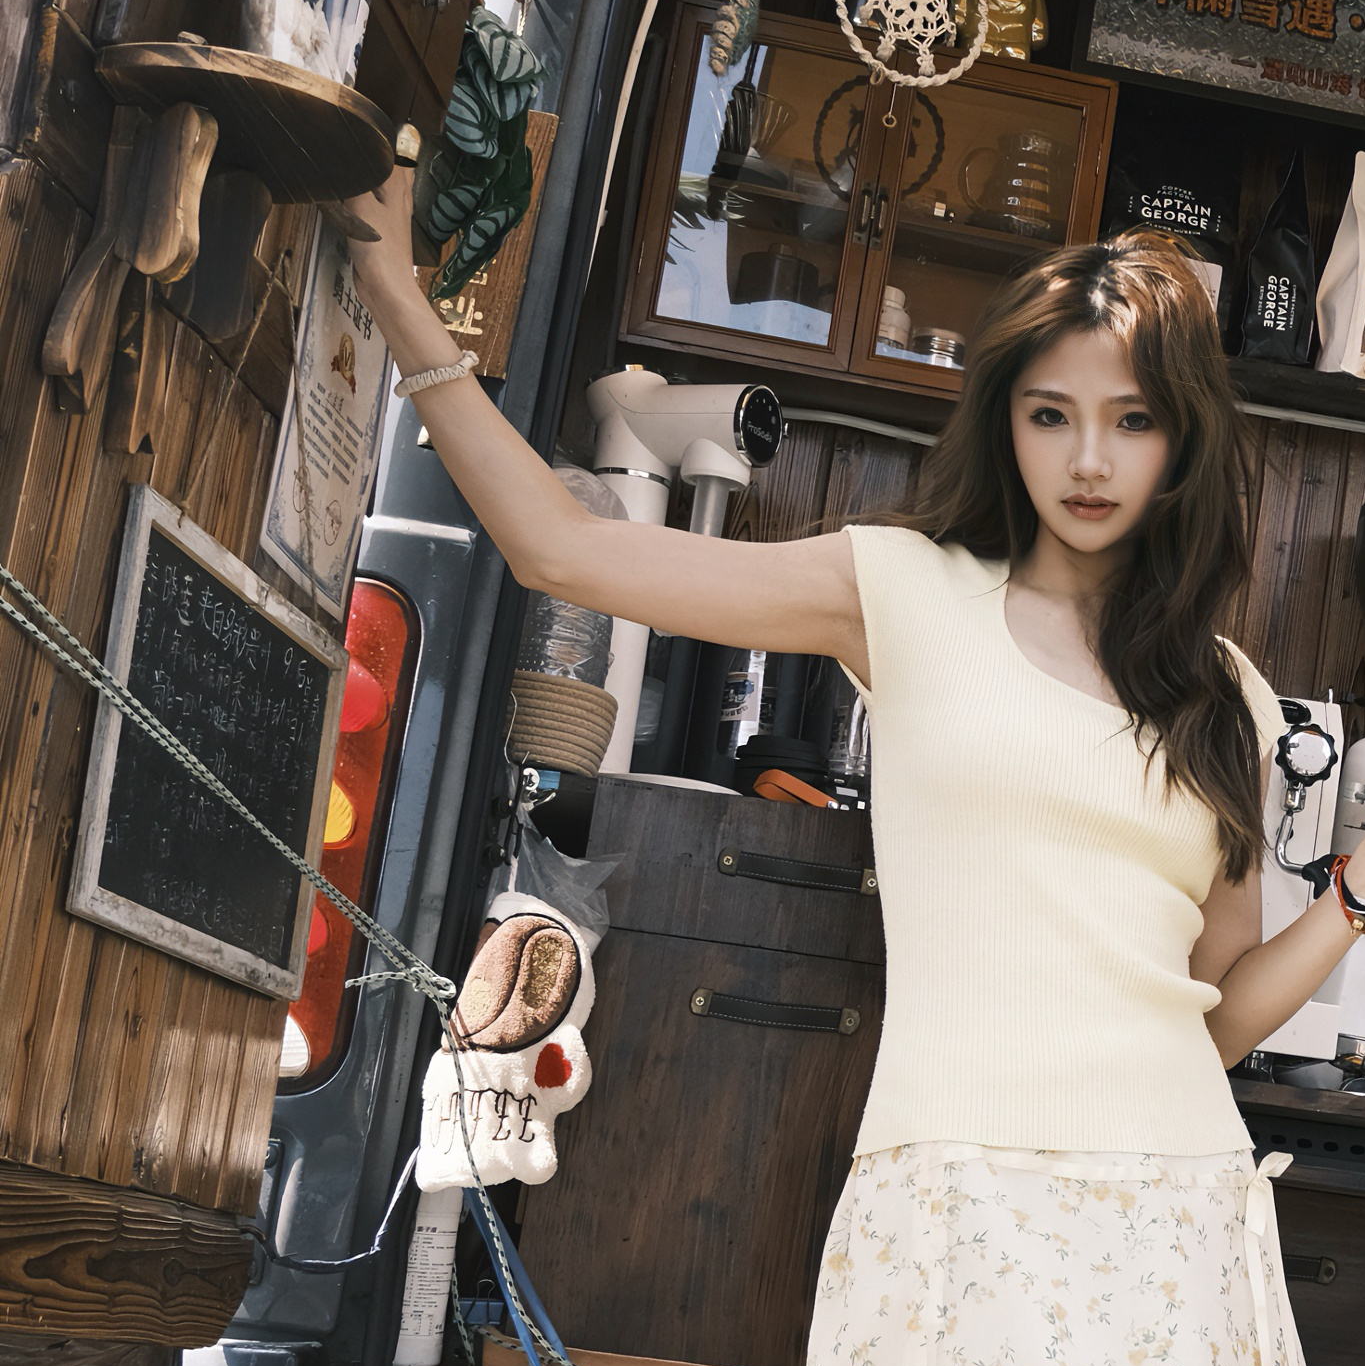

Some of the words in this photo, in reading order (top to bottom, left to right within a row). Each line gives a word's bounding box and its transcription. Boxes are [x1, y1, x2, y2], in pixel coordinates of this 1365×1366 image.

[1141, 195, 1211, 217] CAPTAIN
[1141, 207, 1209, 230] GEORGE
[1263, 275, 1278, 328] GEORGE
[1275, 277, 1290, 332] CAPTAIN
